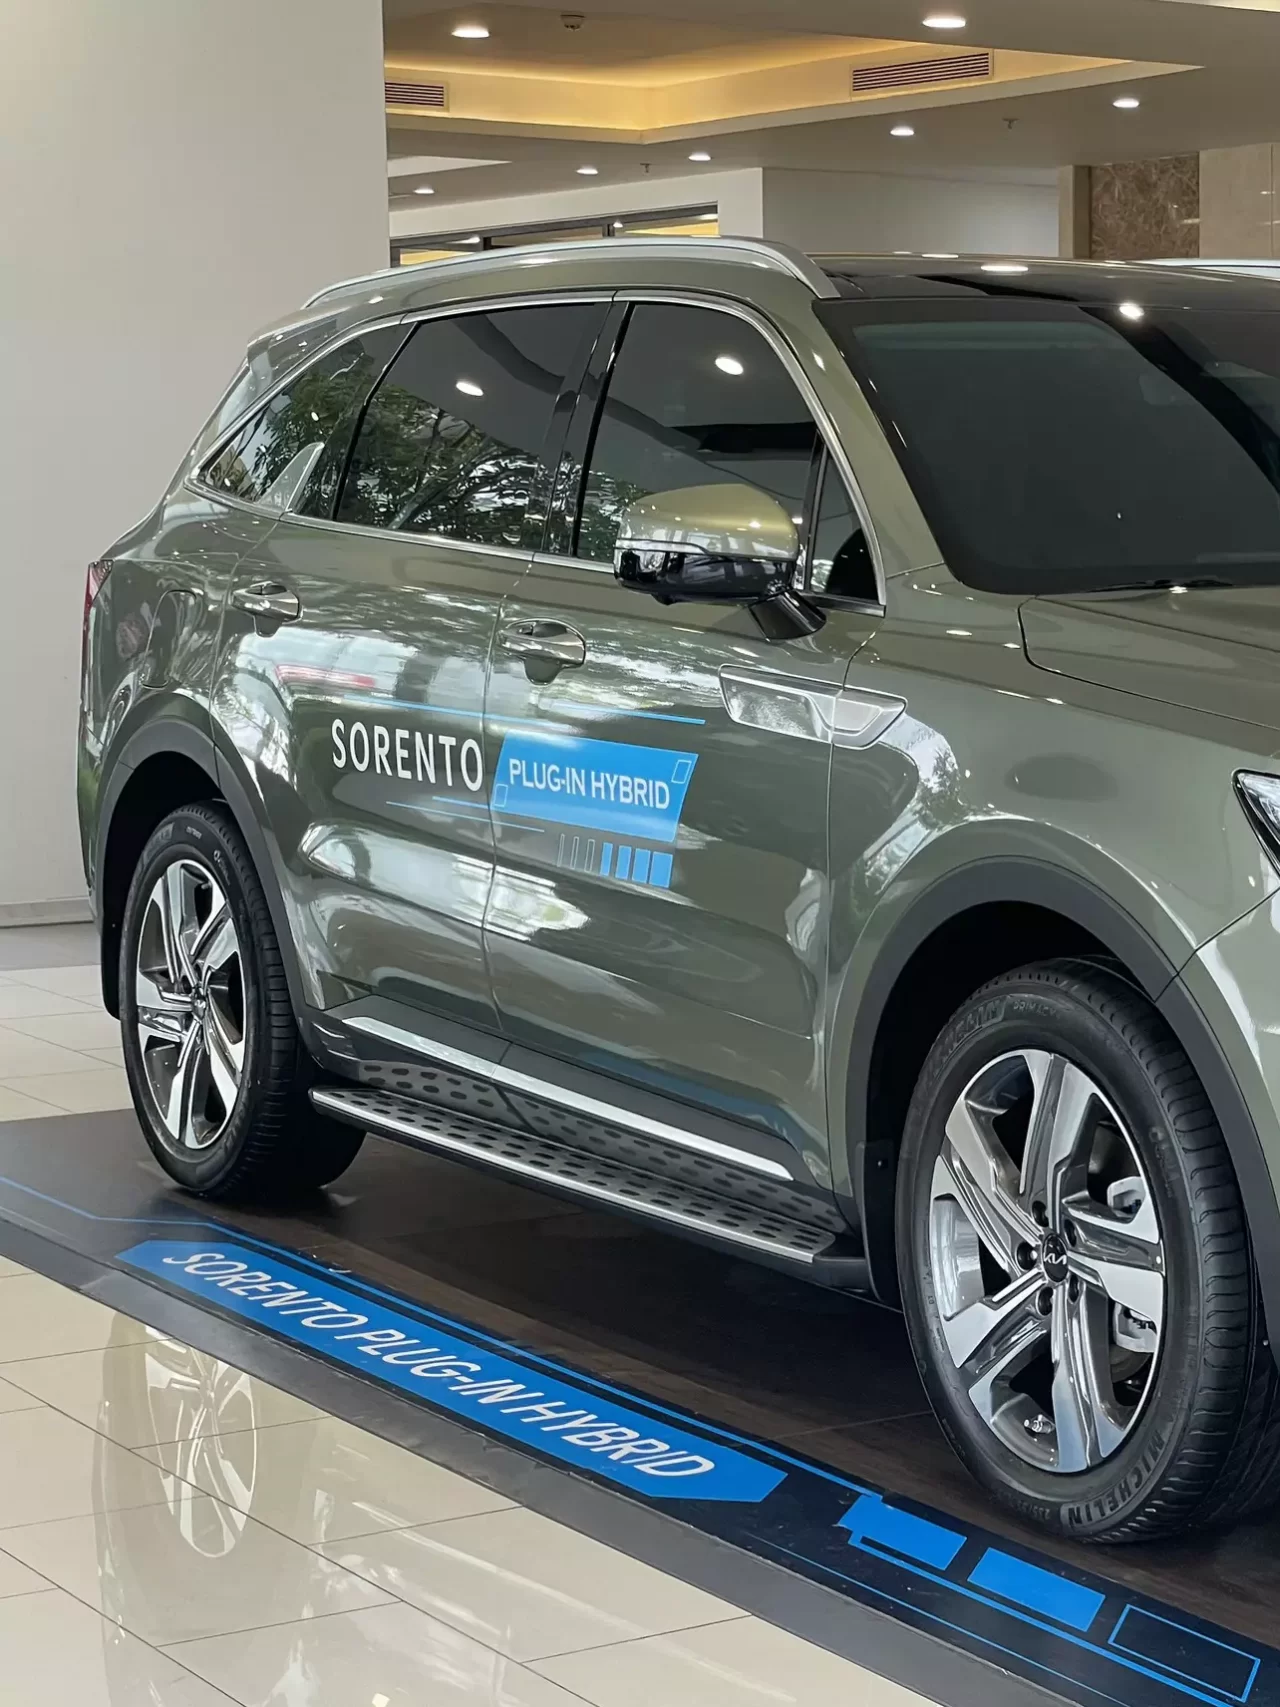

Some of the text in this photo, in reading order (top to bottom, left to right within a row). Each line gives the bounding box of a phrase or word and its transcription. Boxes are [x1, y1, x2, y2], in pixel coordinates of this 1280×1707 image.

[331, 718, 484, 792] SORENTO
[509, 758, 671, 809] PLUG-IN HYBRID
[162, 1252, 716, 1477] SORENTO PLUG-IN HYBRID
[1067, 1434, 1166, 1526] MICHELIN
